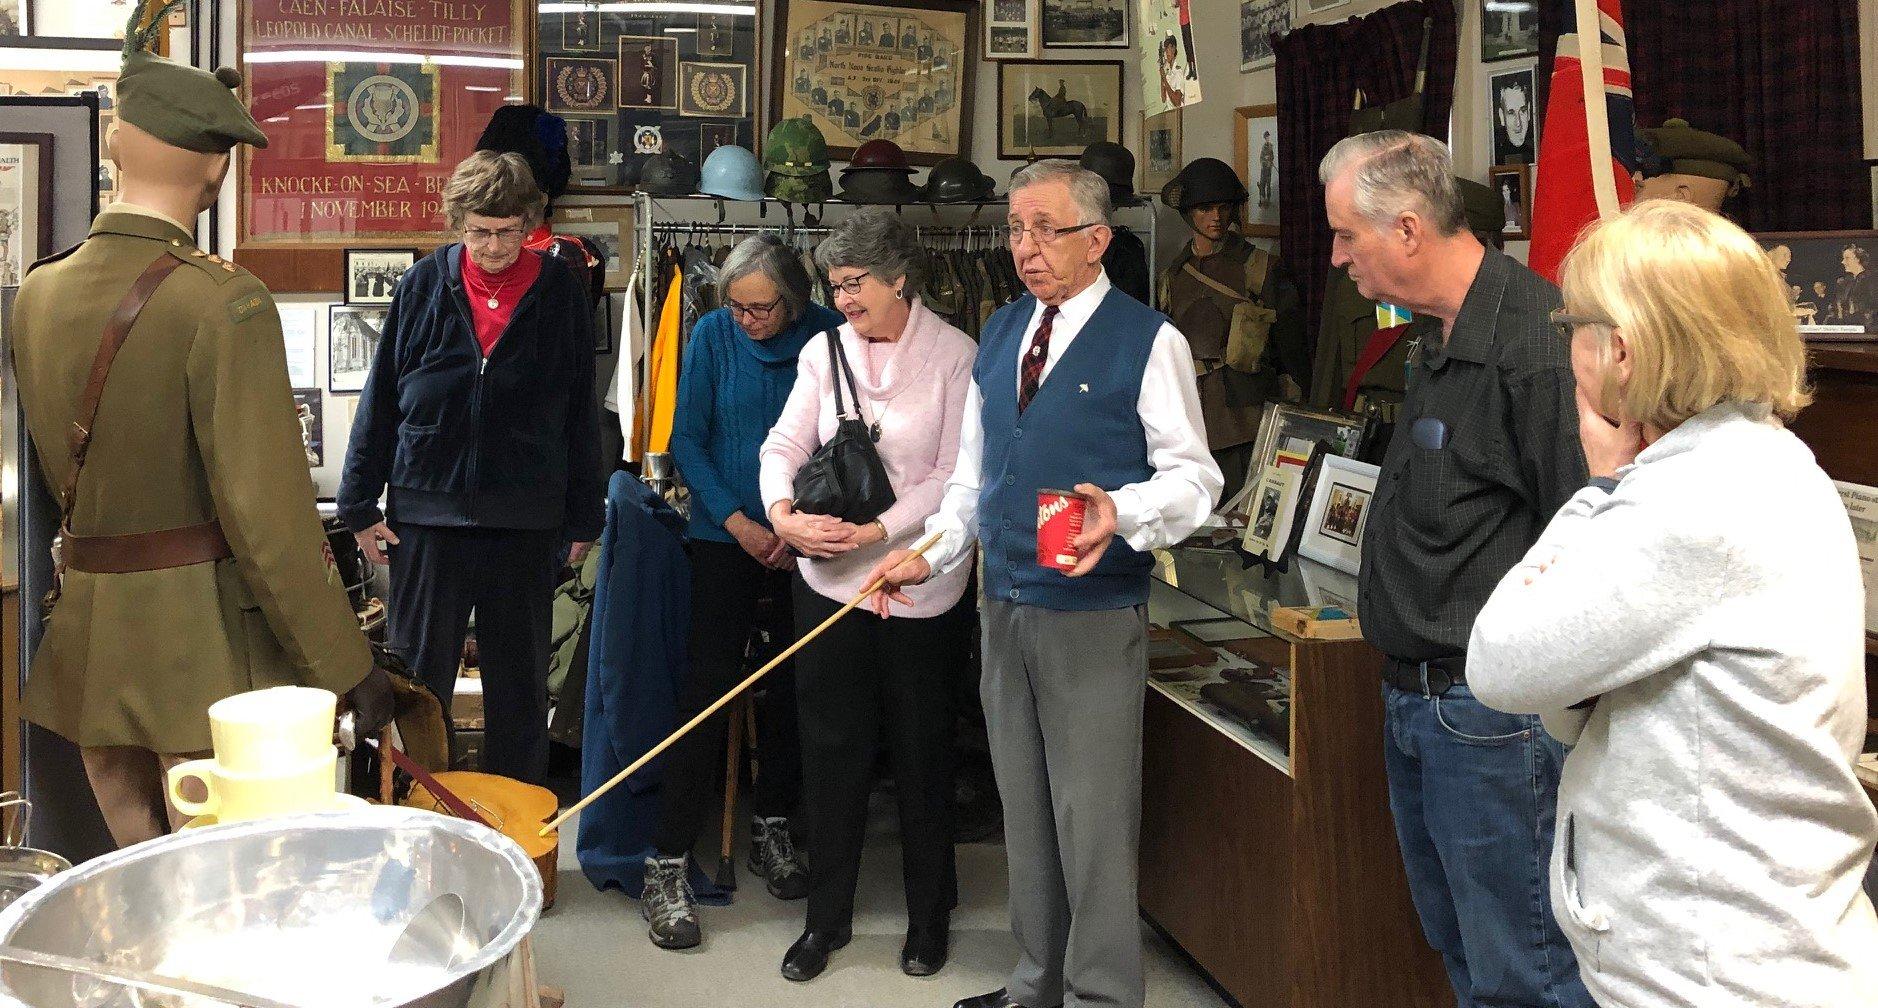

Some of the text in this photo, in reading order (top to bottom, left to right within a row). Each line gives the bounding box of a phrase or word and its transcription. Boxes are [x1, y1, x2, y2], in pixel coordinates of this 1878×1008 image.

[279, 0, 327, 16] CAEN
[339, 0, 417, 18] FALAISE
[428, 1, 487, 20] TILLY
[255, 20, 321, 38] LEOPOLD
[324, 22, 378, 40] CANAL
[310, 200, 412, 219] NOVEMBER
